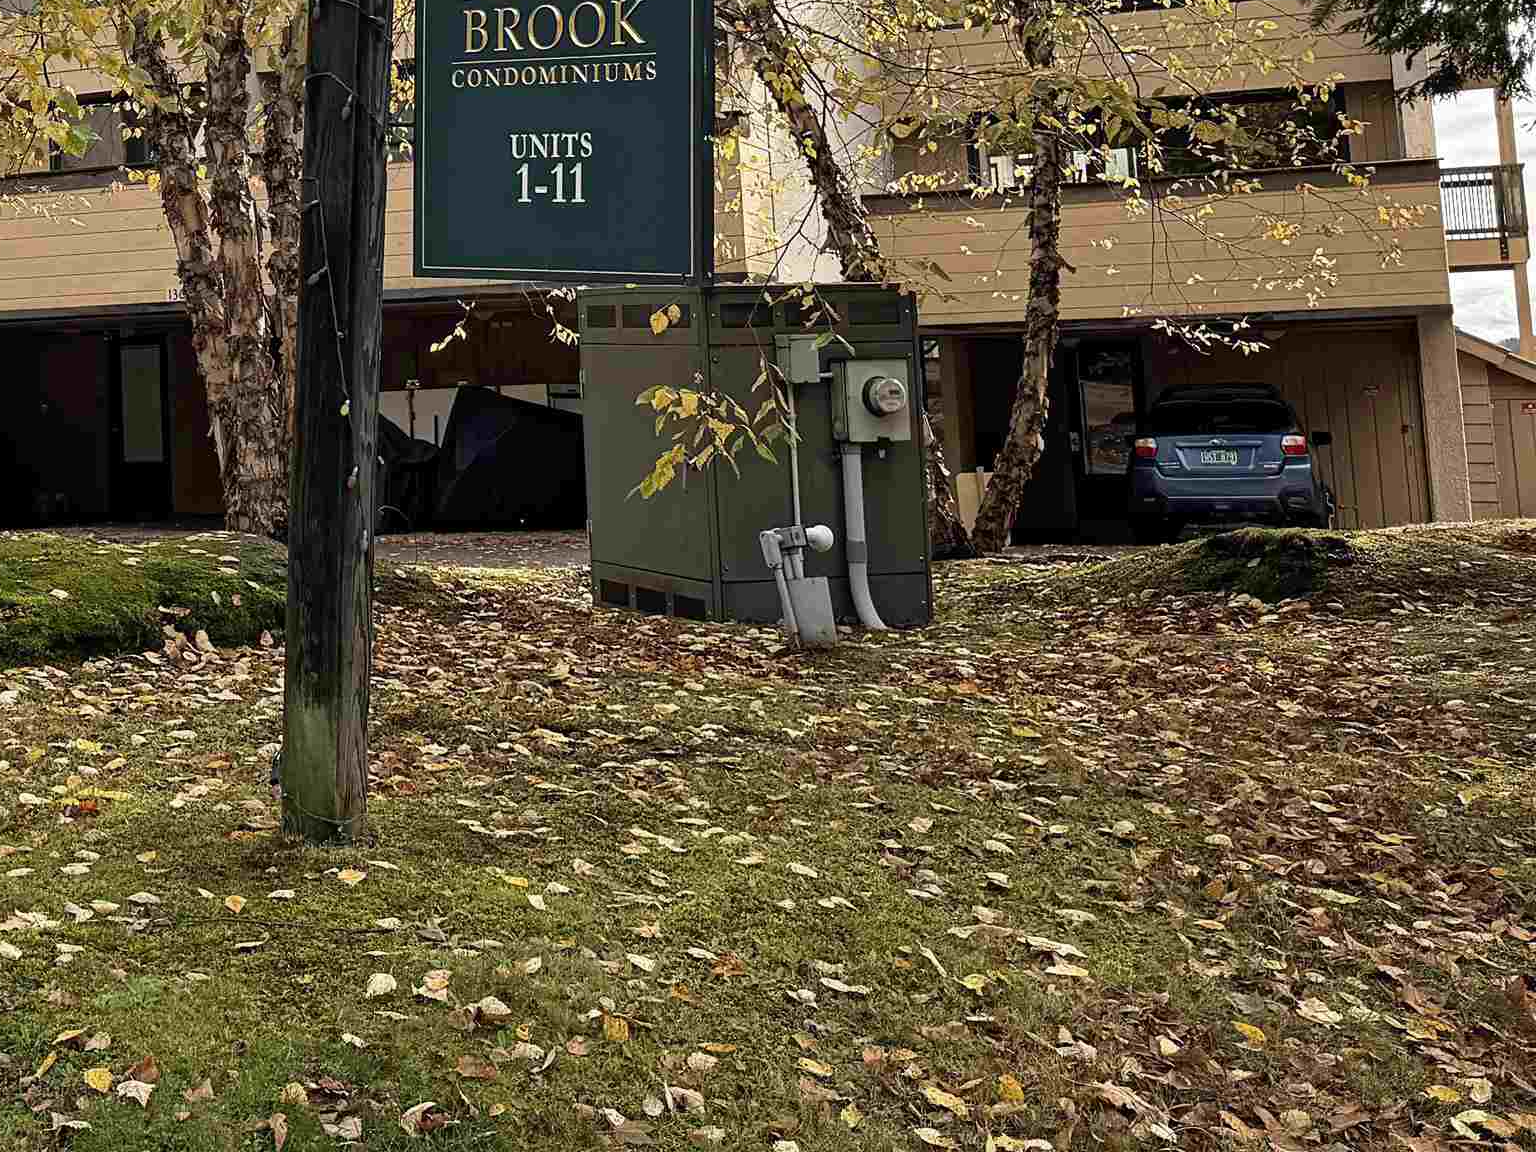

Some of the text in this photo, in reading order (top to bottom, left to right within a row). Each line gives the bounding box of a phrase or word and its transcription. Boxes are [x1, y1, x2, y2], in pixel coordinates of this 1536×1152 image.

[451, 60, 657, 88] CONDOMINIUMS
[510, 132, 593, 159] UNITS
[516, 162, 586, 203] 1-11
